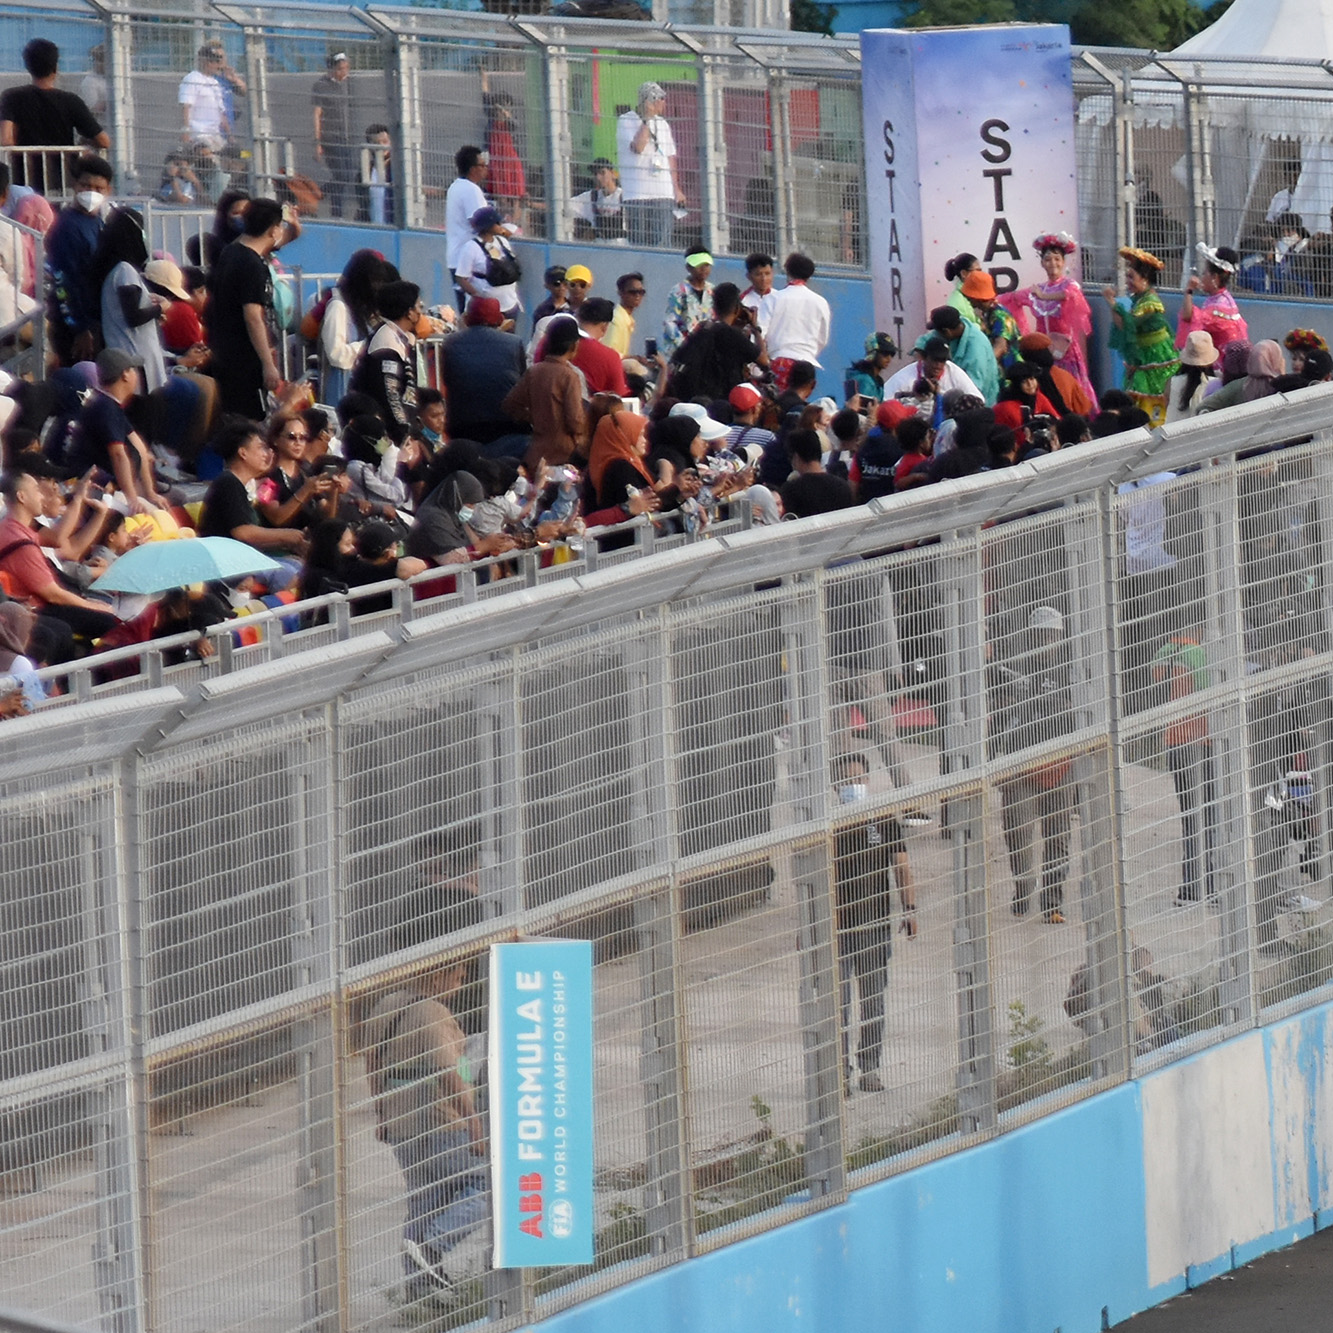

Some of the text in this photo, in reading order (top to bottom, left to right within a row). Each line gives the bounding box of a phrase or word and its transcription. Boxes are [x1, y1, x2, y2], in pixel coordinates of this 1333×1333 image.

[883, 119, 905, 359] START
[979, 118, 1022, 294] STA
[515, 970, 544, 1240] ABB FORMULA E
[553, 969, 571, 1237] FIA WORLD CHAMPIONSHIP
